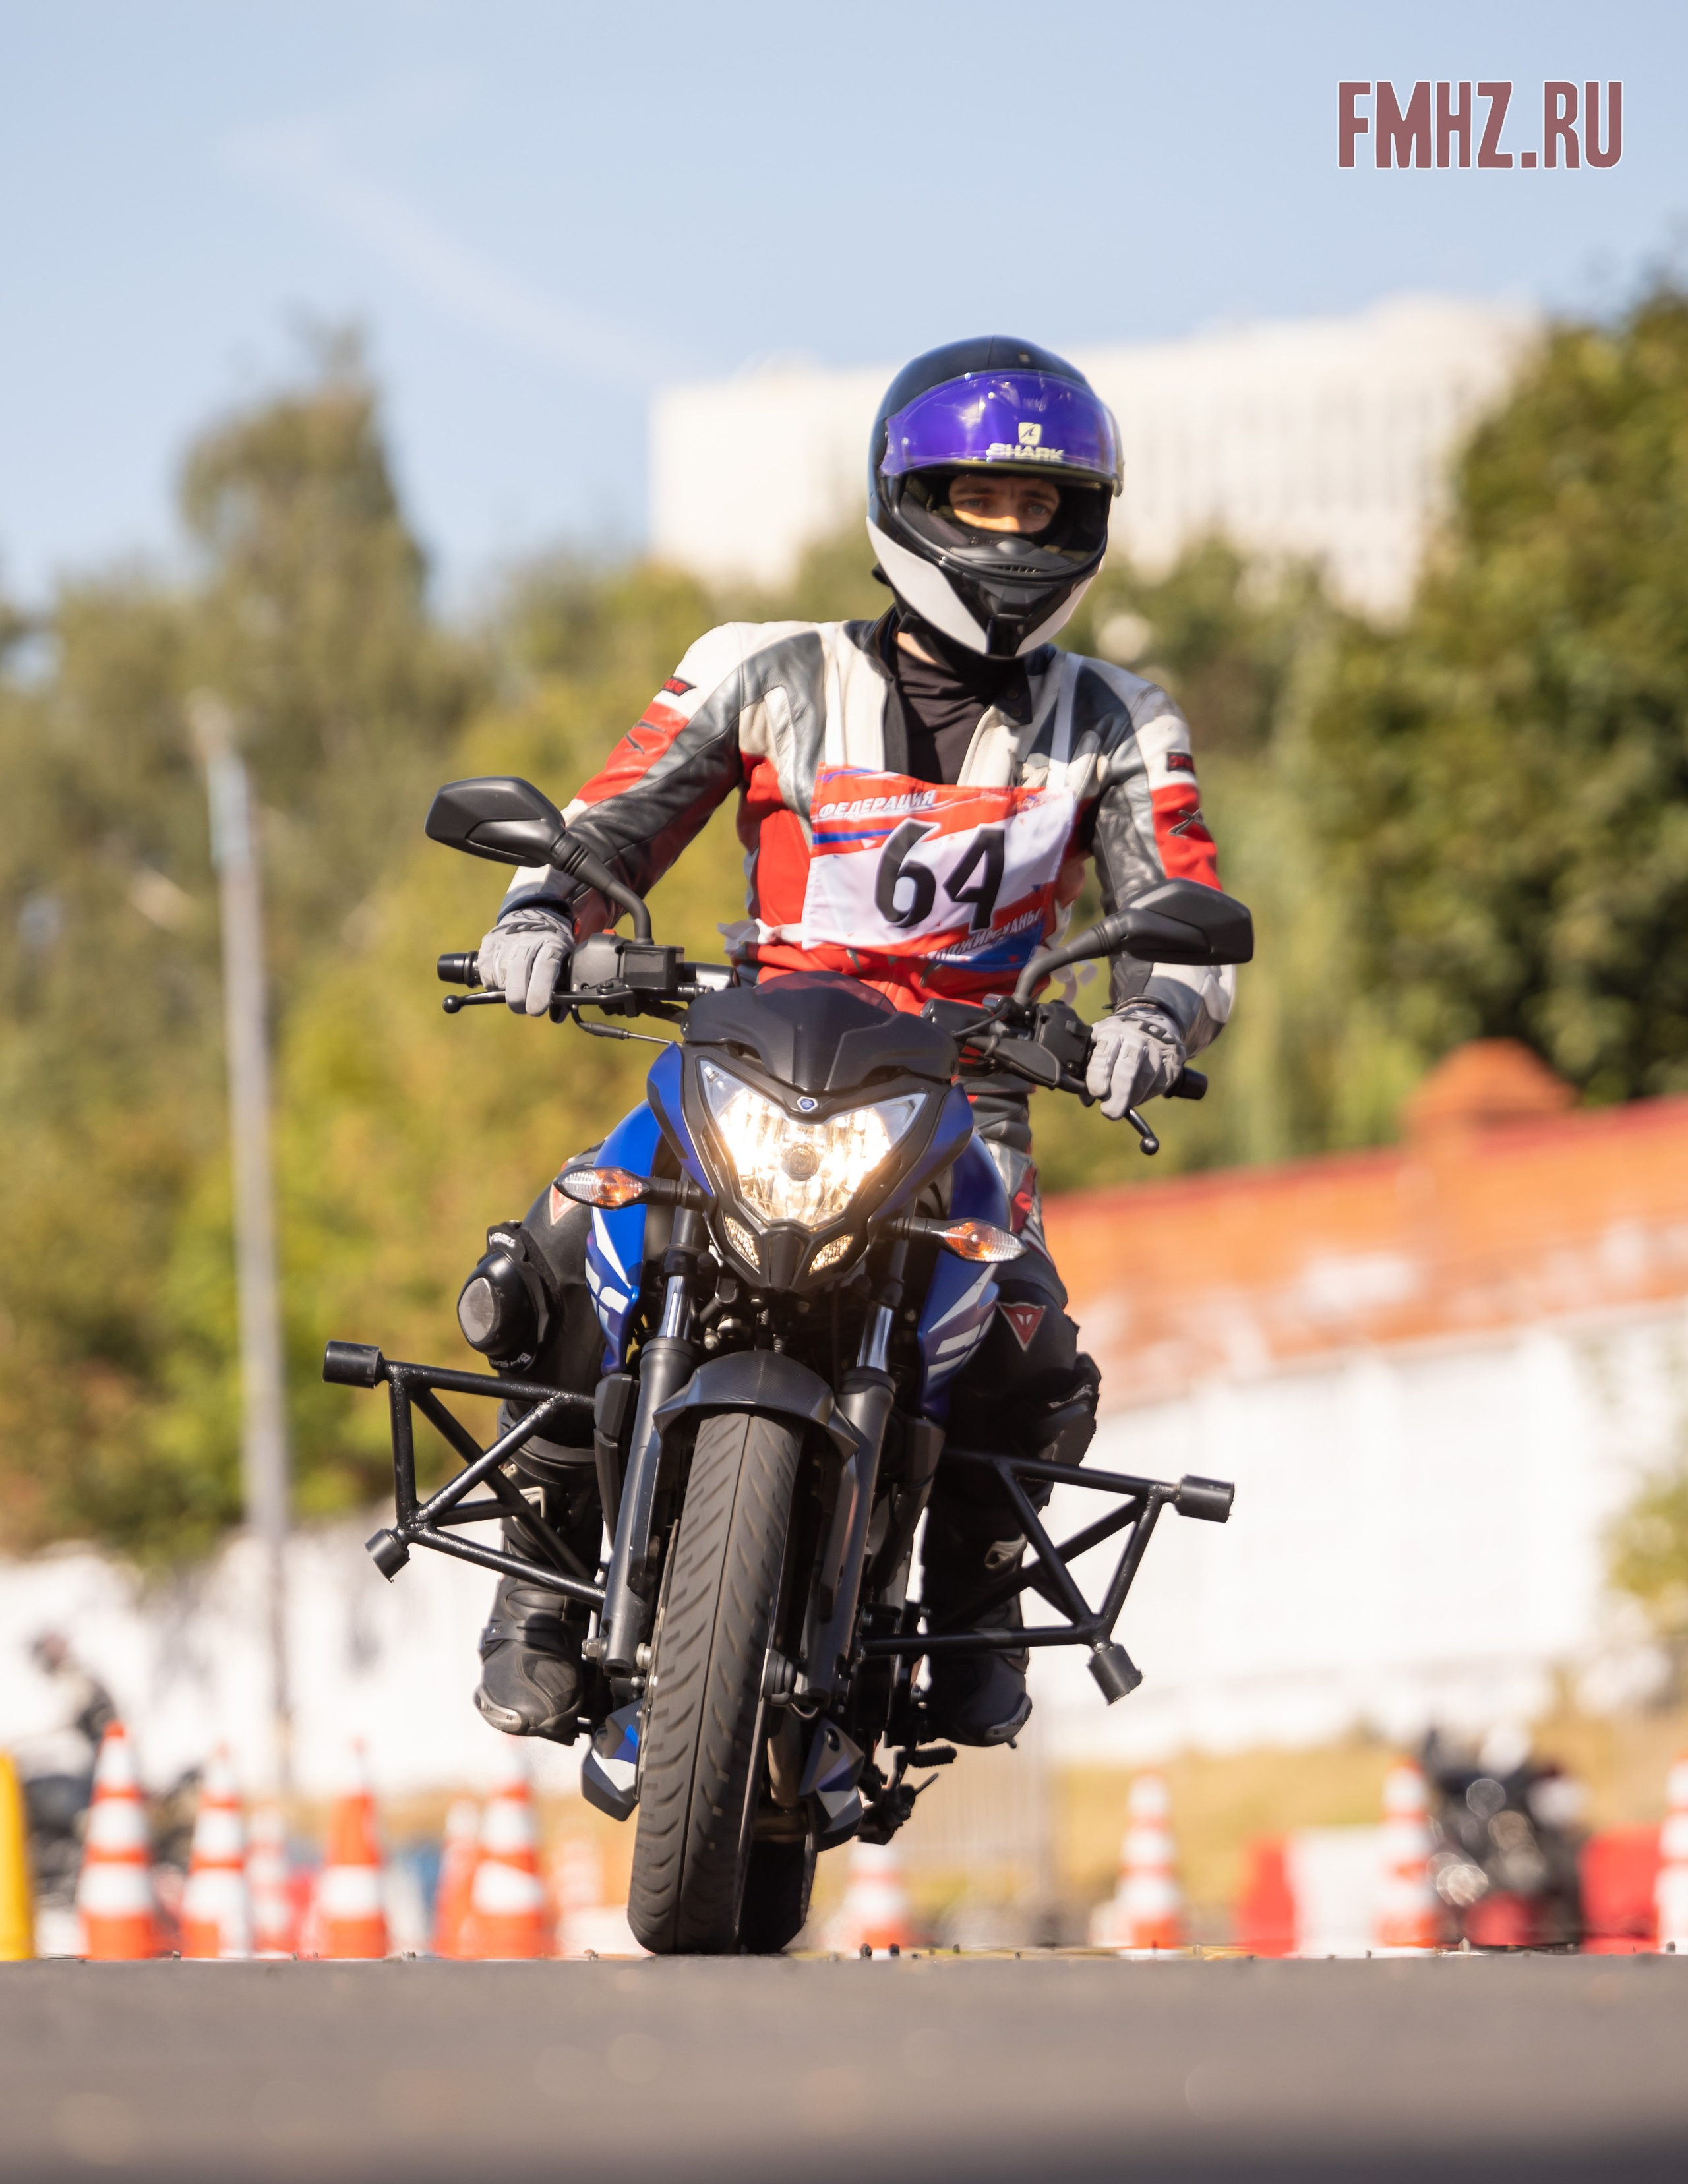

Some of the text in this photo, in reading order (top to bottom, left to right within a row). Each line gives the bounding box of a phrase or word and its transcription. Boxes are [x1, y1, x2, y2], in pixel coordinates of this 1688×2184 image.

[988, 442, 1064, 461] SHARK
[818, 790, 936, 819] ФЕДЕРАЦИЯ
[875, 818, 1006, 933] 64
